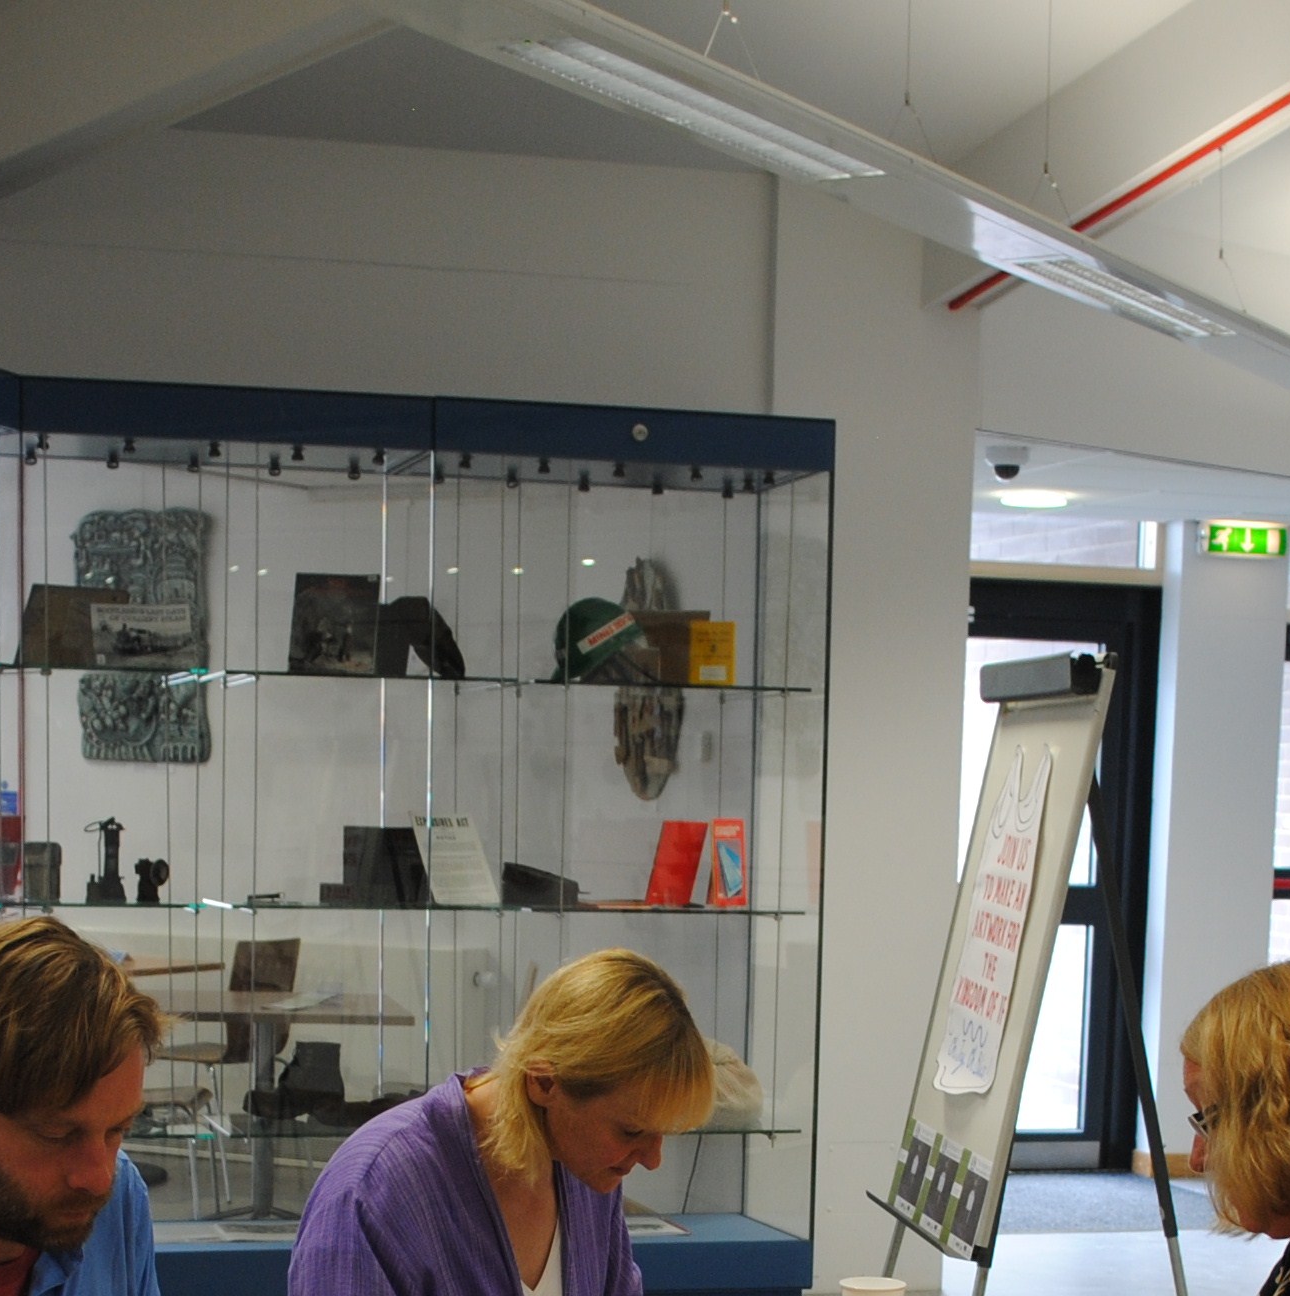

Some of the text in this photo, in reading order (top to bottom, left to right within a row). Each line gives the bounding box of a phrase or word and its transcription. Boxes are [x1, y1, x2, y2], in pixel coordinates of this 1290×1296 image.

[997, 833, 1032, 871] JOIN US
[983, 873, 1028, 912] TO MAKE AN
[971, 909, 1020, 953] ARTWORK FOR
[982, 951, 998, 982] THE
[953, 976, 988, 1016] KINGDOM
[985, 990, 1000, 1020] OF
